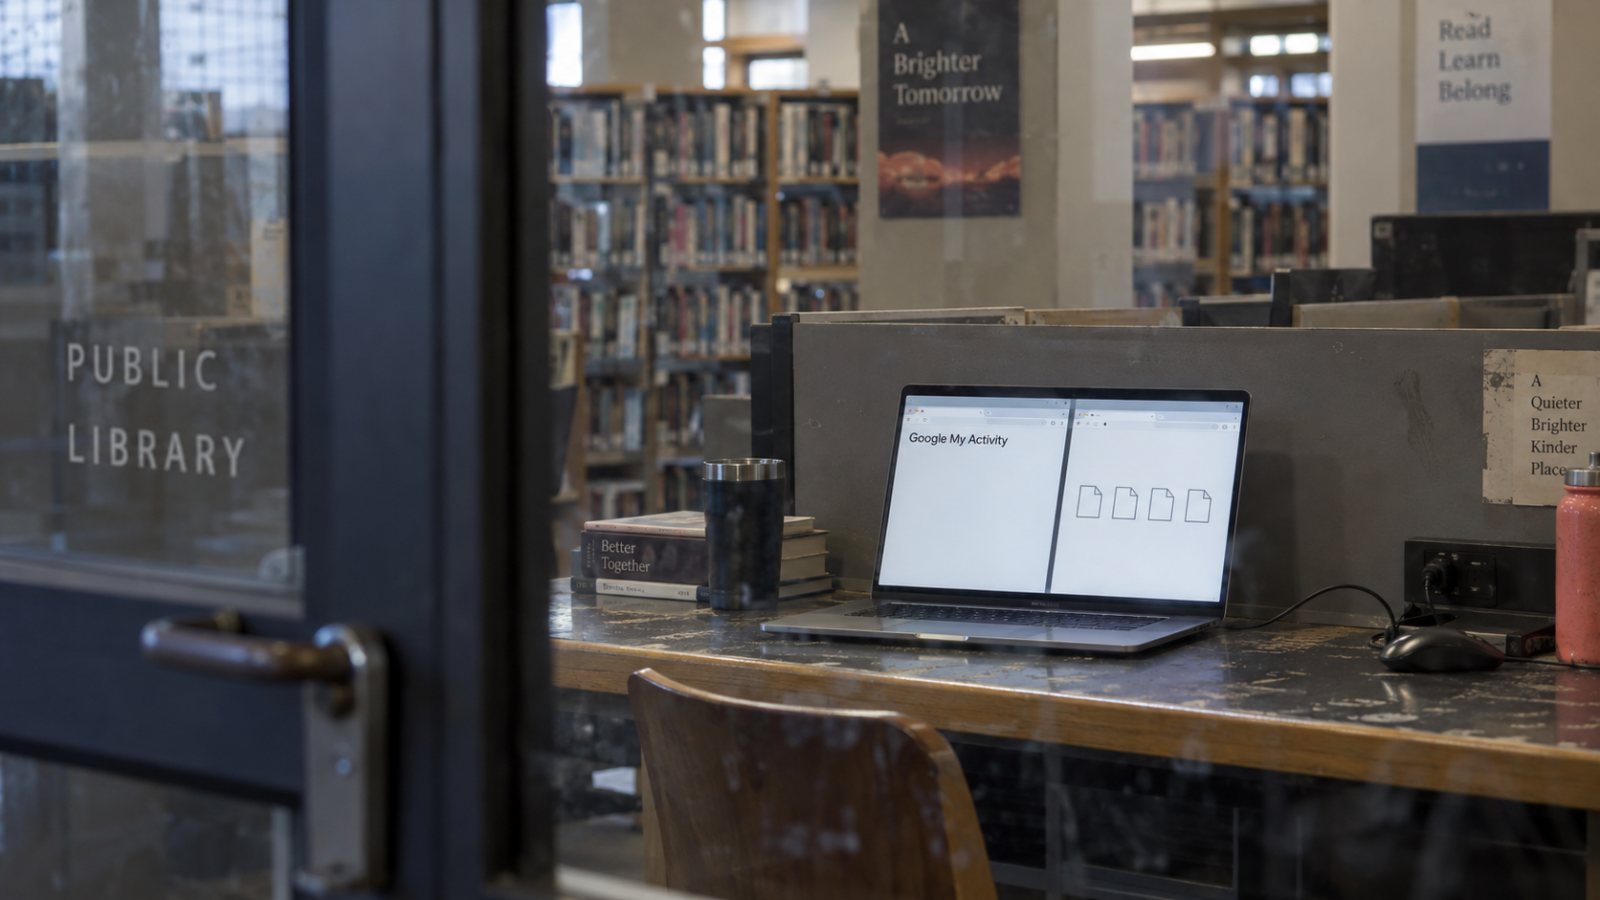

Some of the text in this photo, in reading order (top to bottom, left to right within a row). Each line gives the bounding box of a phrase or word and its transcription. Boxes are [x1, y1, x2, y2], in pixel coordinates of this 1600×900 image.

[892, 22, 910, 44] A
[1439, 16, 1491, 41] Read
[893, 51, 982, 79] Brighter
[1439, 50, 1500, 72] Learn
[893, 83, 1003, 106] Tomorrow
[1439, 78, 1512, 105] Belong
[67, 342, 217, 391] PUBLIC
[1531, 374, 1541, 387] A
[1531, 395, 1582, 411] Quieter
[1531, 417, 1587, 435] Brighter
[909, 432, 1008, 448] Google My Activity
[1531, 440, 1577, 454] Kinder
[68, 423, 244, 478] LIBRARY
[1531, 461, 1567, 476] Place
[601, 539, 636, 554] Better
[601, 556, 650, 574] Together
